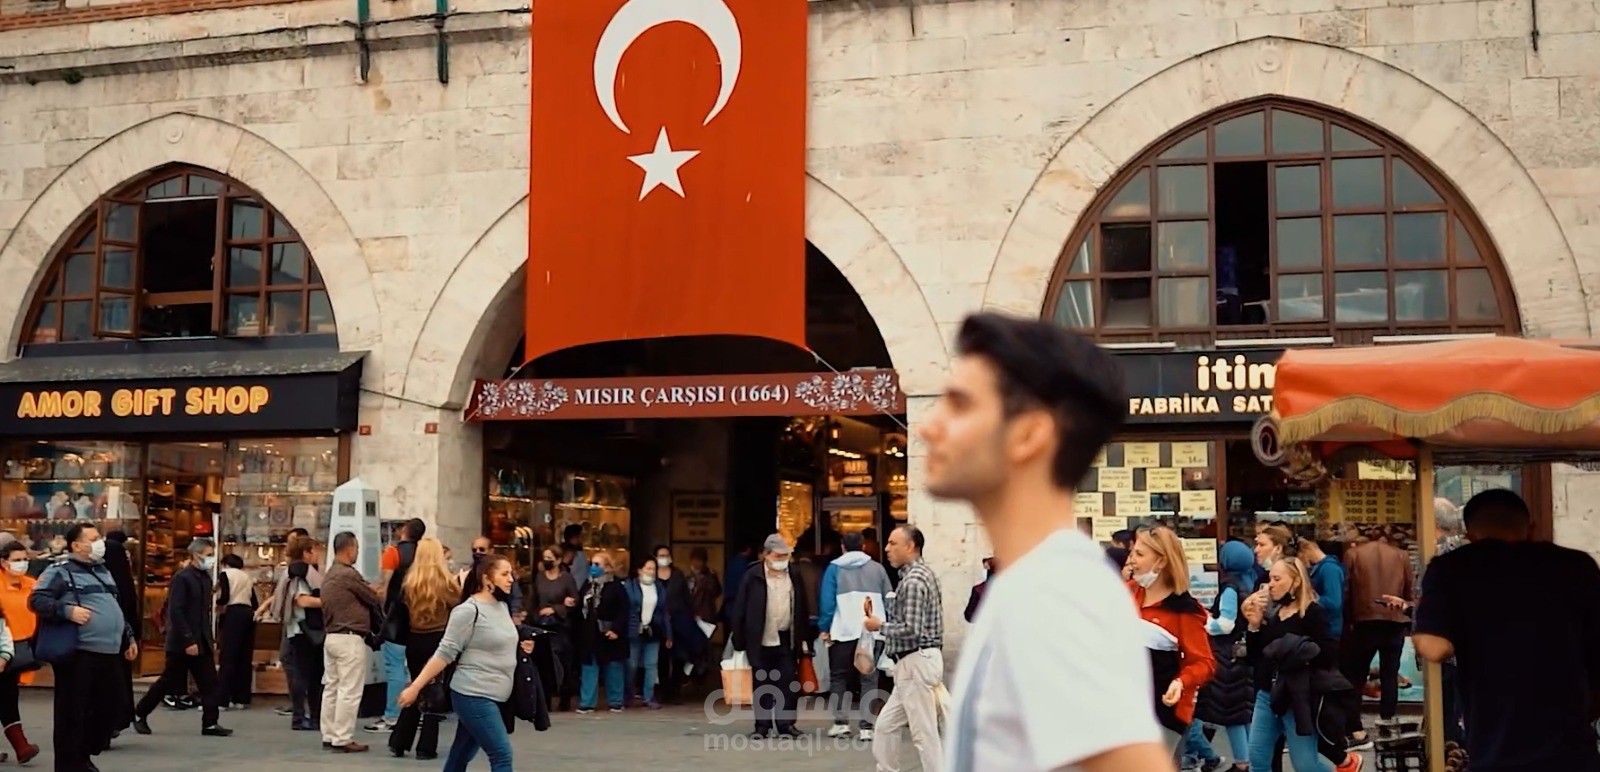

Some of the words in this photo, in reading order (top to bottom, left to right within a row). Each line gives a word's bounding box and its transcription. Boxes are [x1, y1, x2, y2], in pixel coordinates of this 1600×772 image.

[17, 390, 101, 418] AMOR
[111, 388, 176, 417] GIFT
[184, 386, 270, 415] SHOP
[574, 387, 636, 405] MISIR
[640, 386, 725, 408] ÇARŞISI
[730, 384, 790, 406] (1664)
[1129, 392, 1220, 415] FABRİKA
